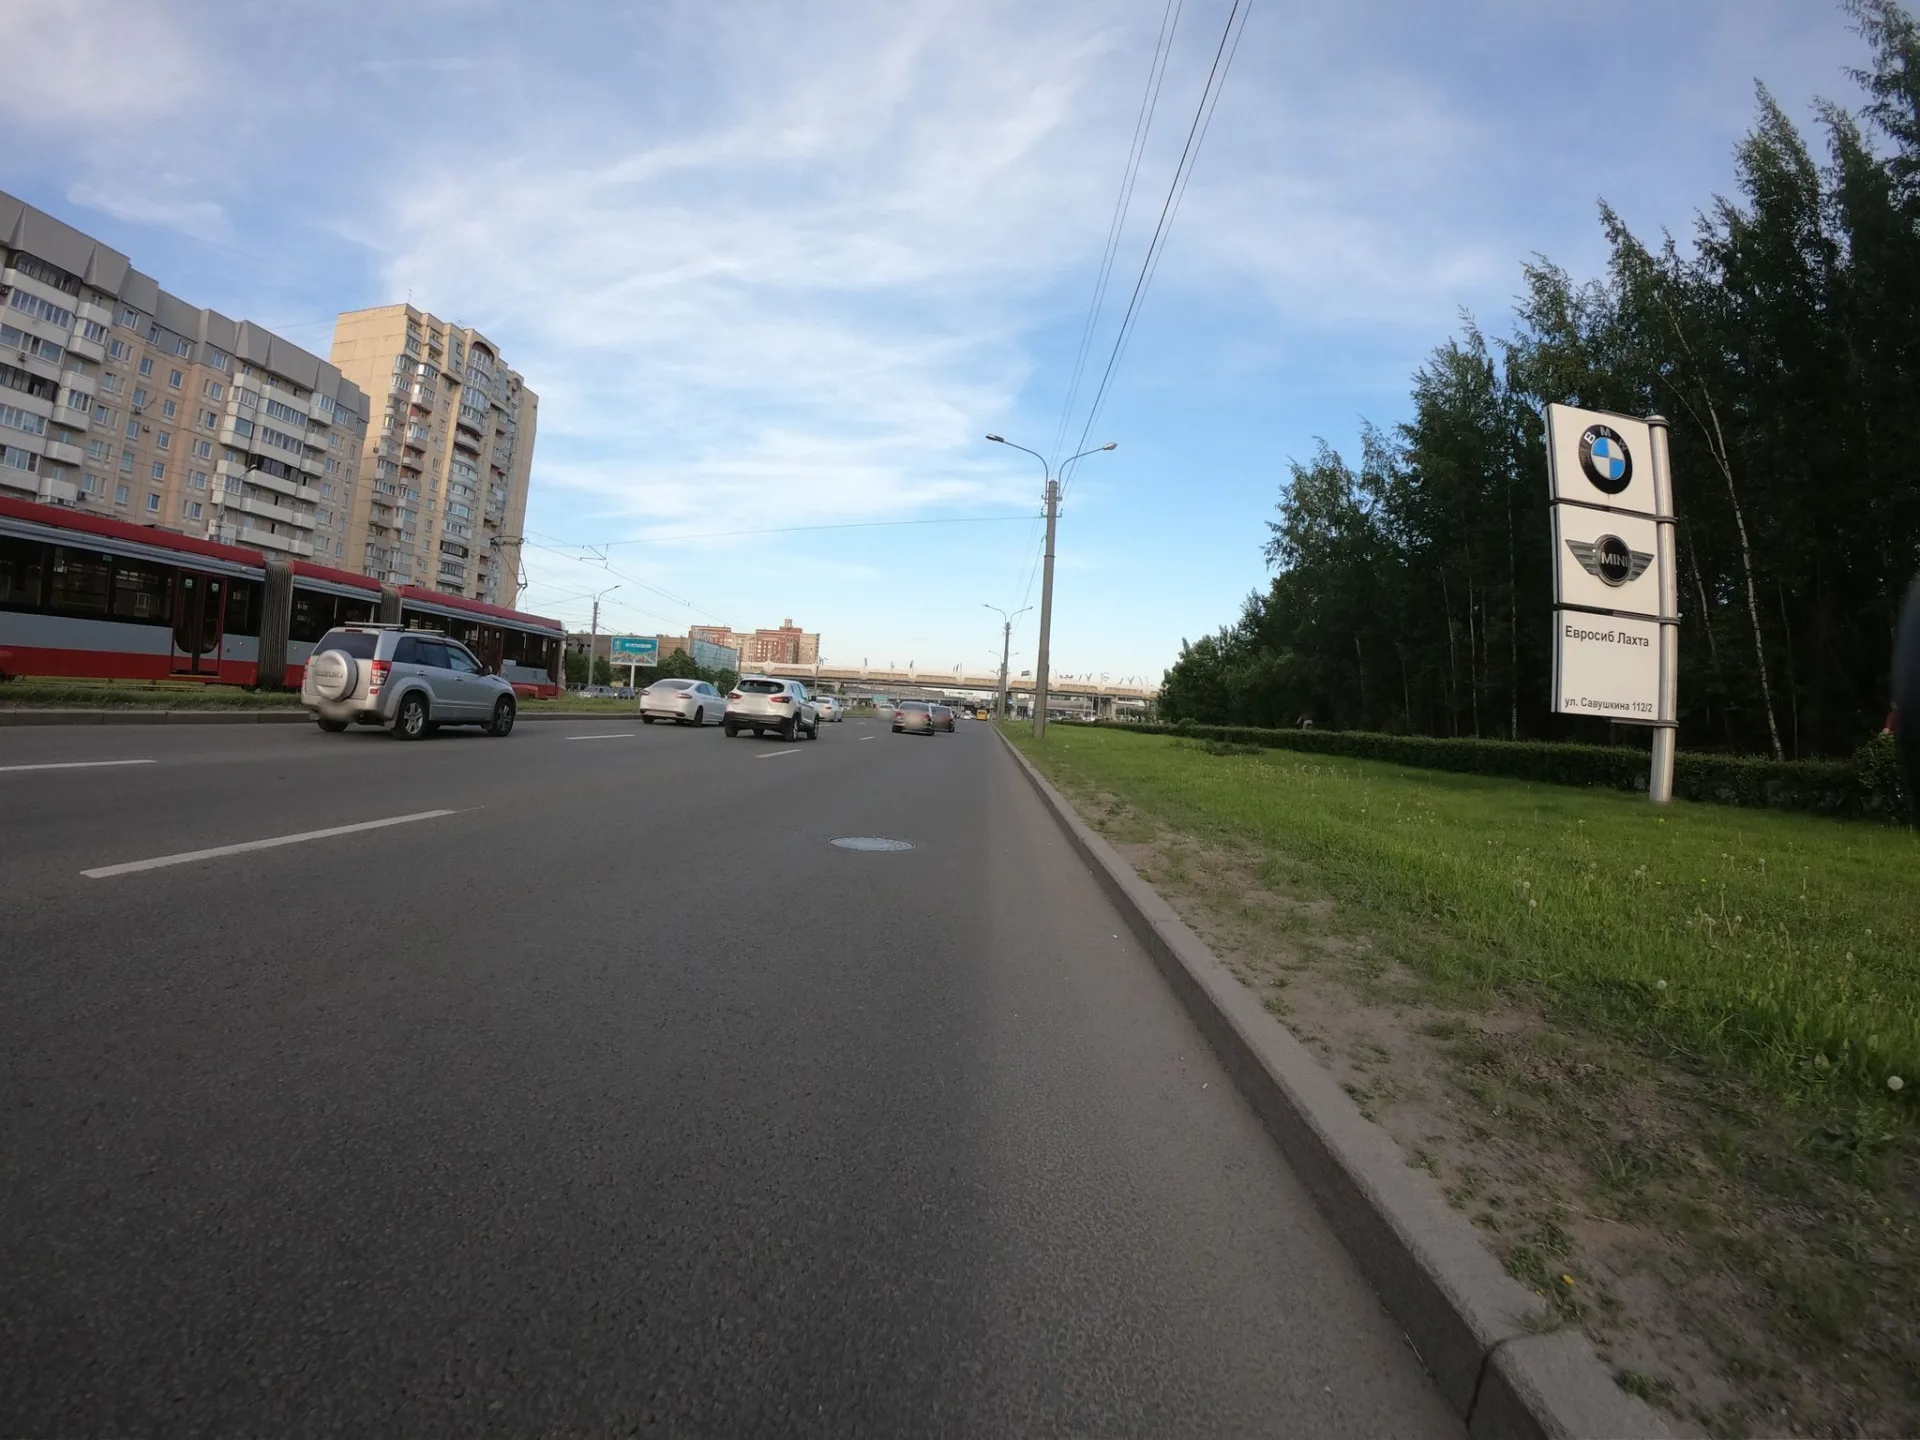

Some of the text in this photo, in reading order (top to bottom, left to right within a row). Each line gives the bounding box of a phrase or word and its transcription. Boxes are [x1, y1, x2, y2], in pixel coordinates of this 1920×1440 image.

[1583, 426, 1627, 450] BMW
[1601, 552, 1627, 567] MINI
[1565, 625, 1649, 647] Евросиб Лахта
[1564, 697, 1653, 713] ул. Савушкина 112/2
